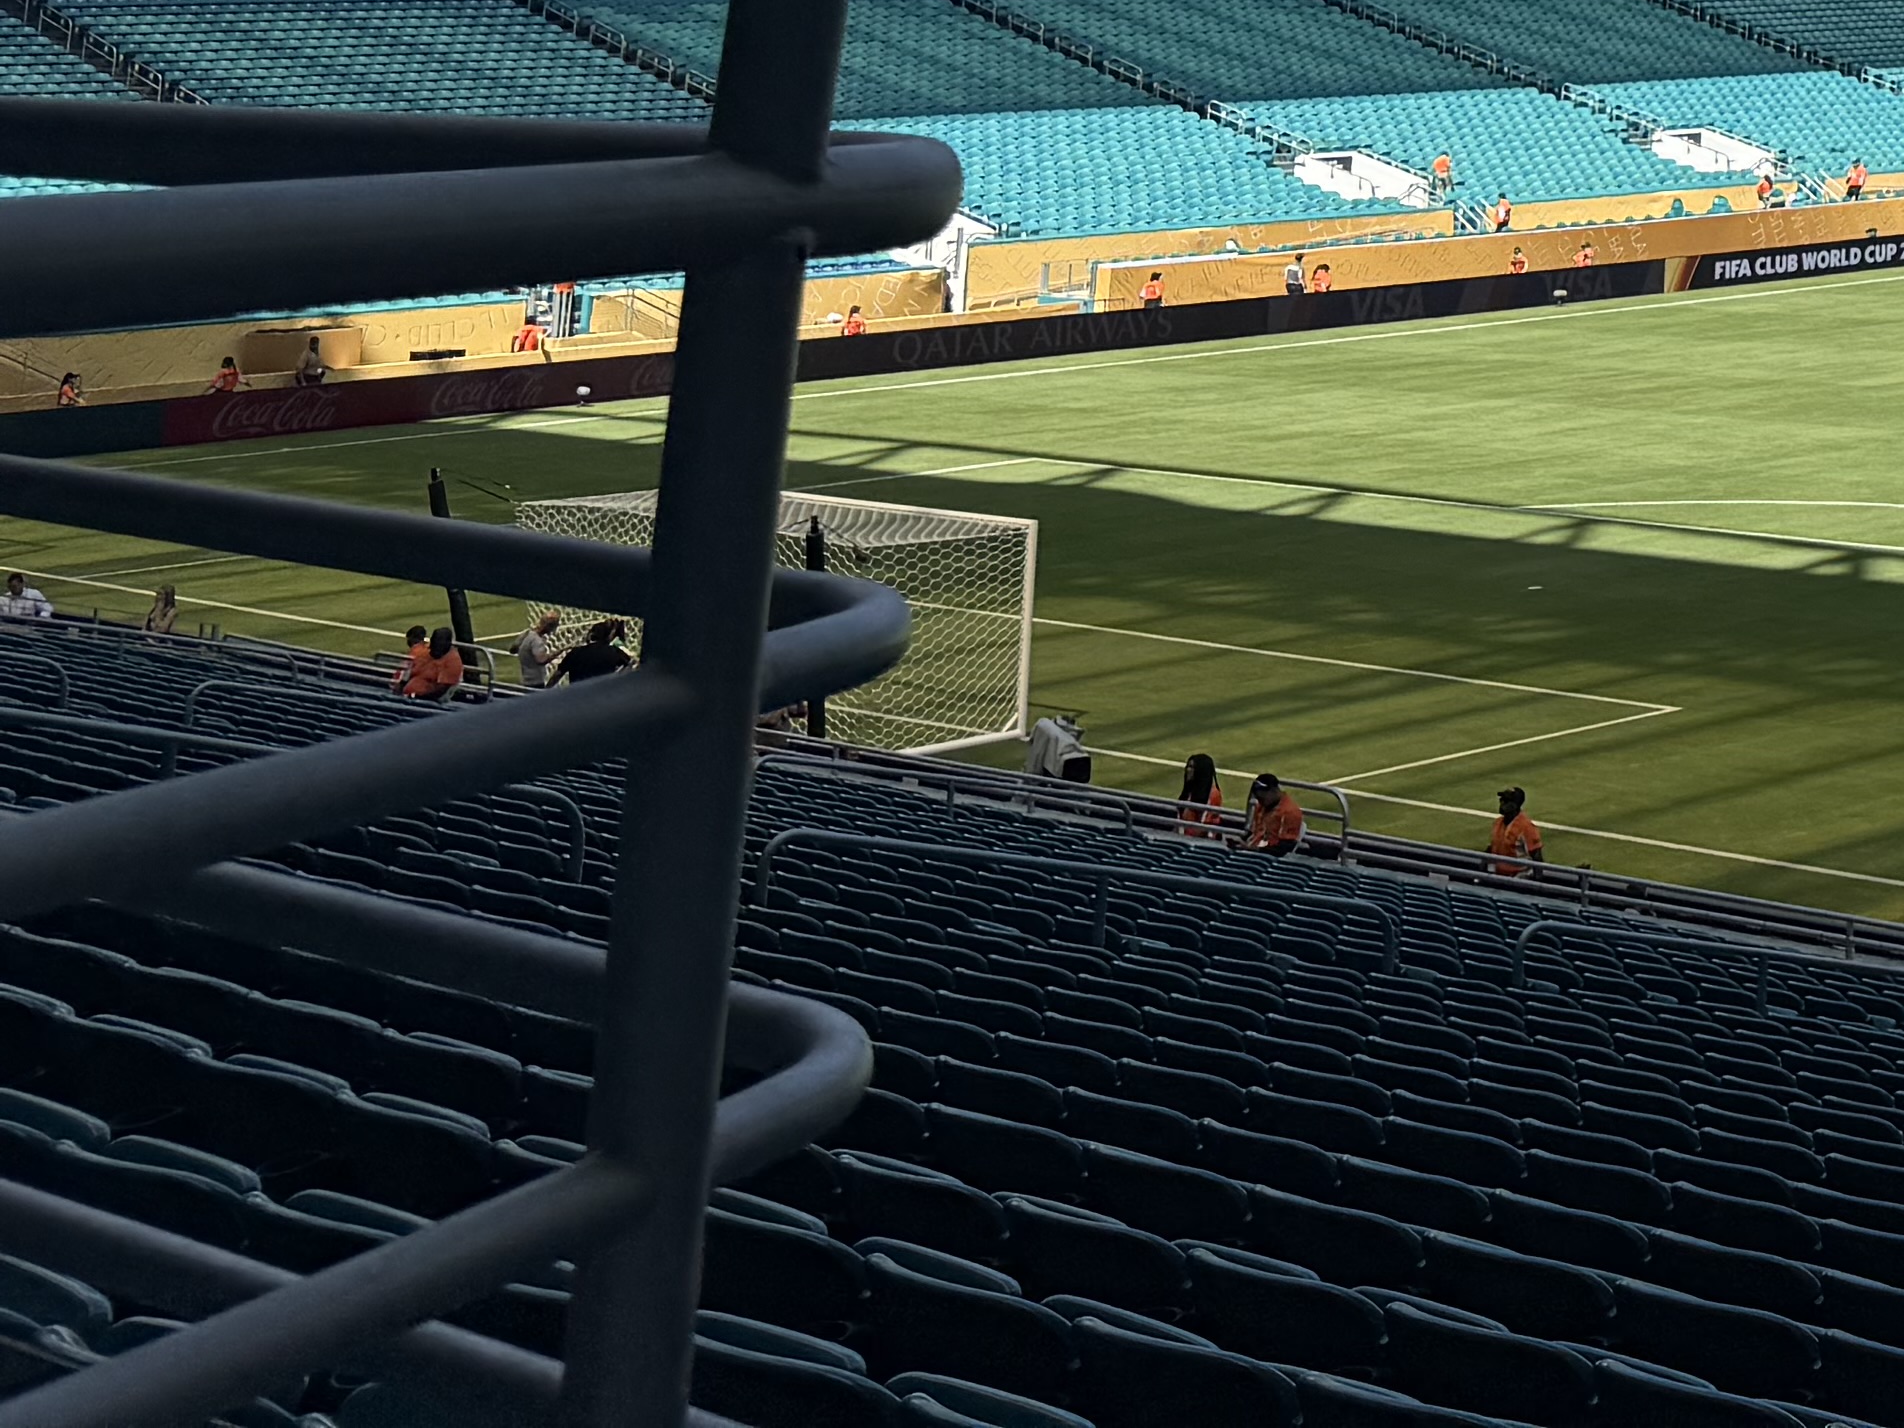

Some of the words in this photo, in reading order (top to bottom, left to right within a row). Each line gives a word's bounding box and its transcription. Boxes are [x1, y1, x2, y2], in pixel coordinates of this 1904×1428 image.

[1714, 258, 1751, 280] FIFA
[1755, 253, 1798, 275] CLUB
[1801, 247, 1861, 270] WORLD
[1864, 243, 1897, 264] CUP
[1350, 286, 1425, 324] VISA
[893, 327, 1013, 368] QATAR
[1030, 309, 1173, 349] AIRWAYS
